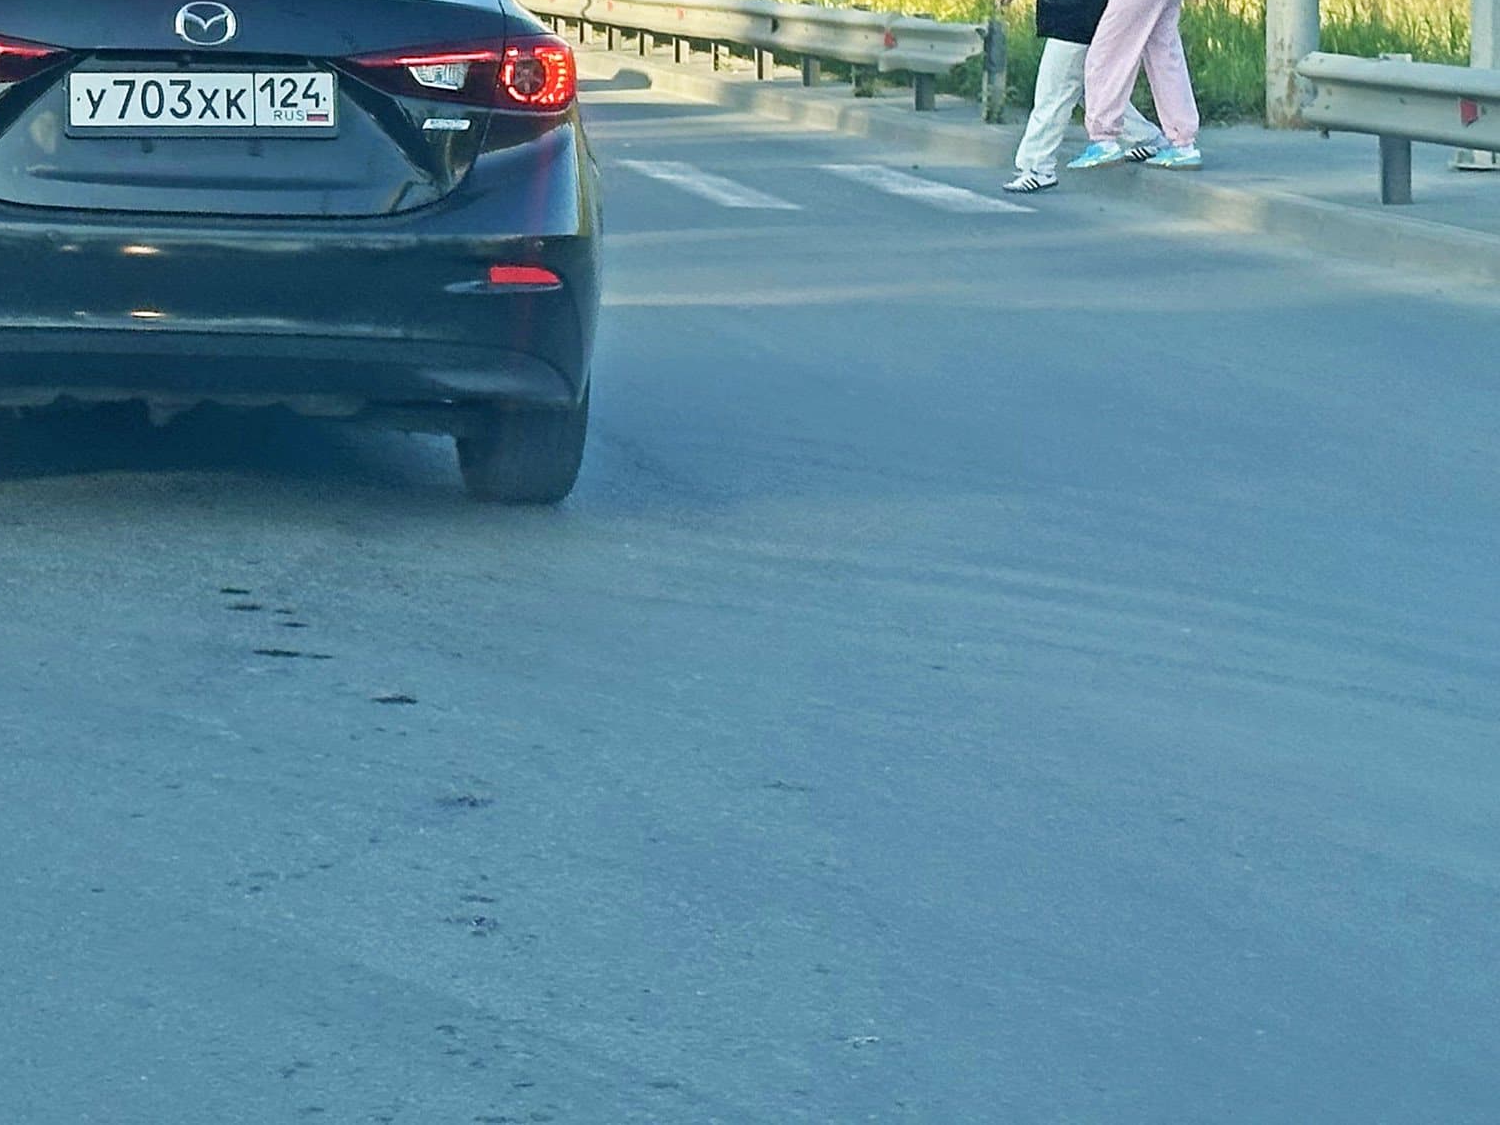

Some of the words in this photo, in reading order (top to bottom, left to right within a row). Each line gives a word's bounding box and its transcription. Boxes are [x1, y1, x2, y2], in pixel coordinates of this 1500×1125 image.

[85, 79, 247, 119] У703ХК
[258, 78, 320, 108] 124
[273, 110, 305, 121] RUS
